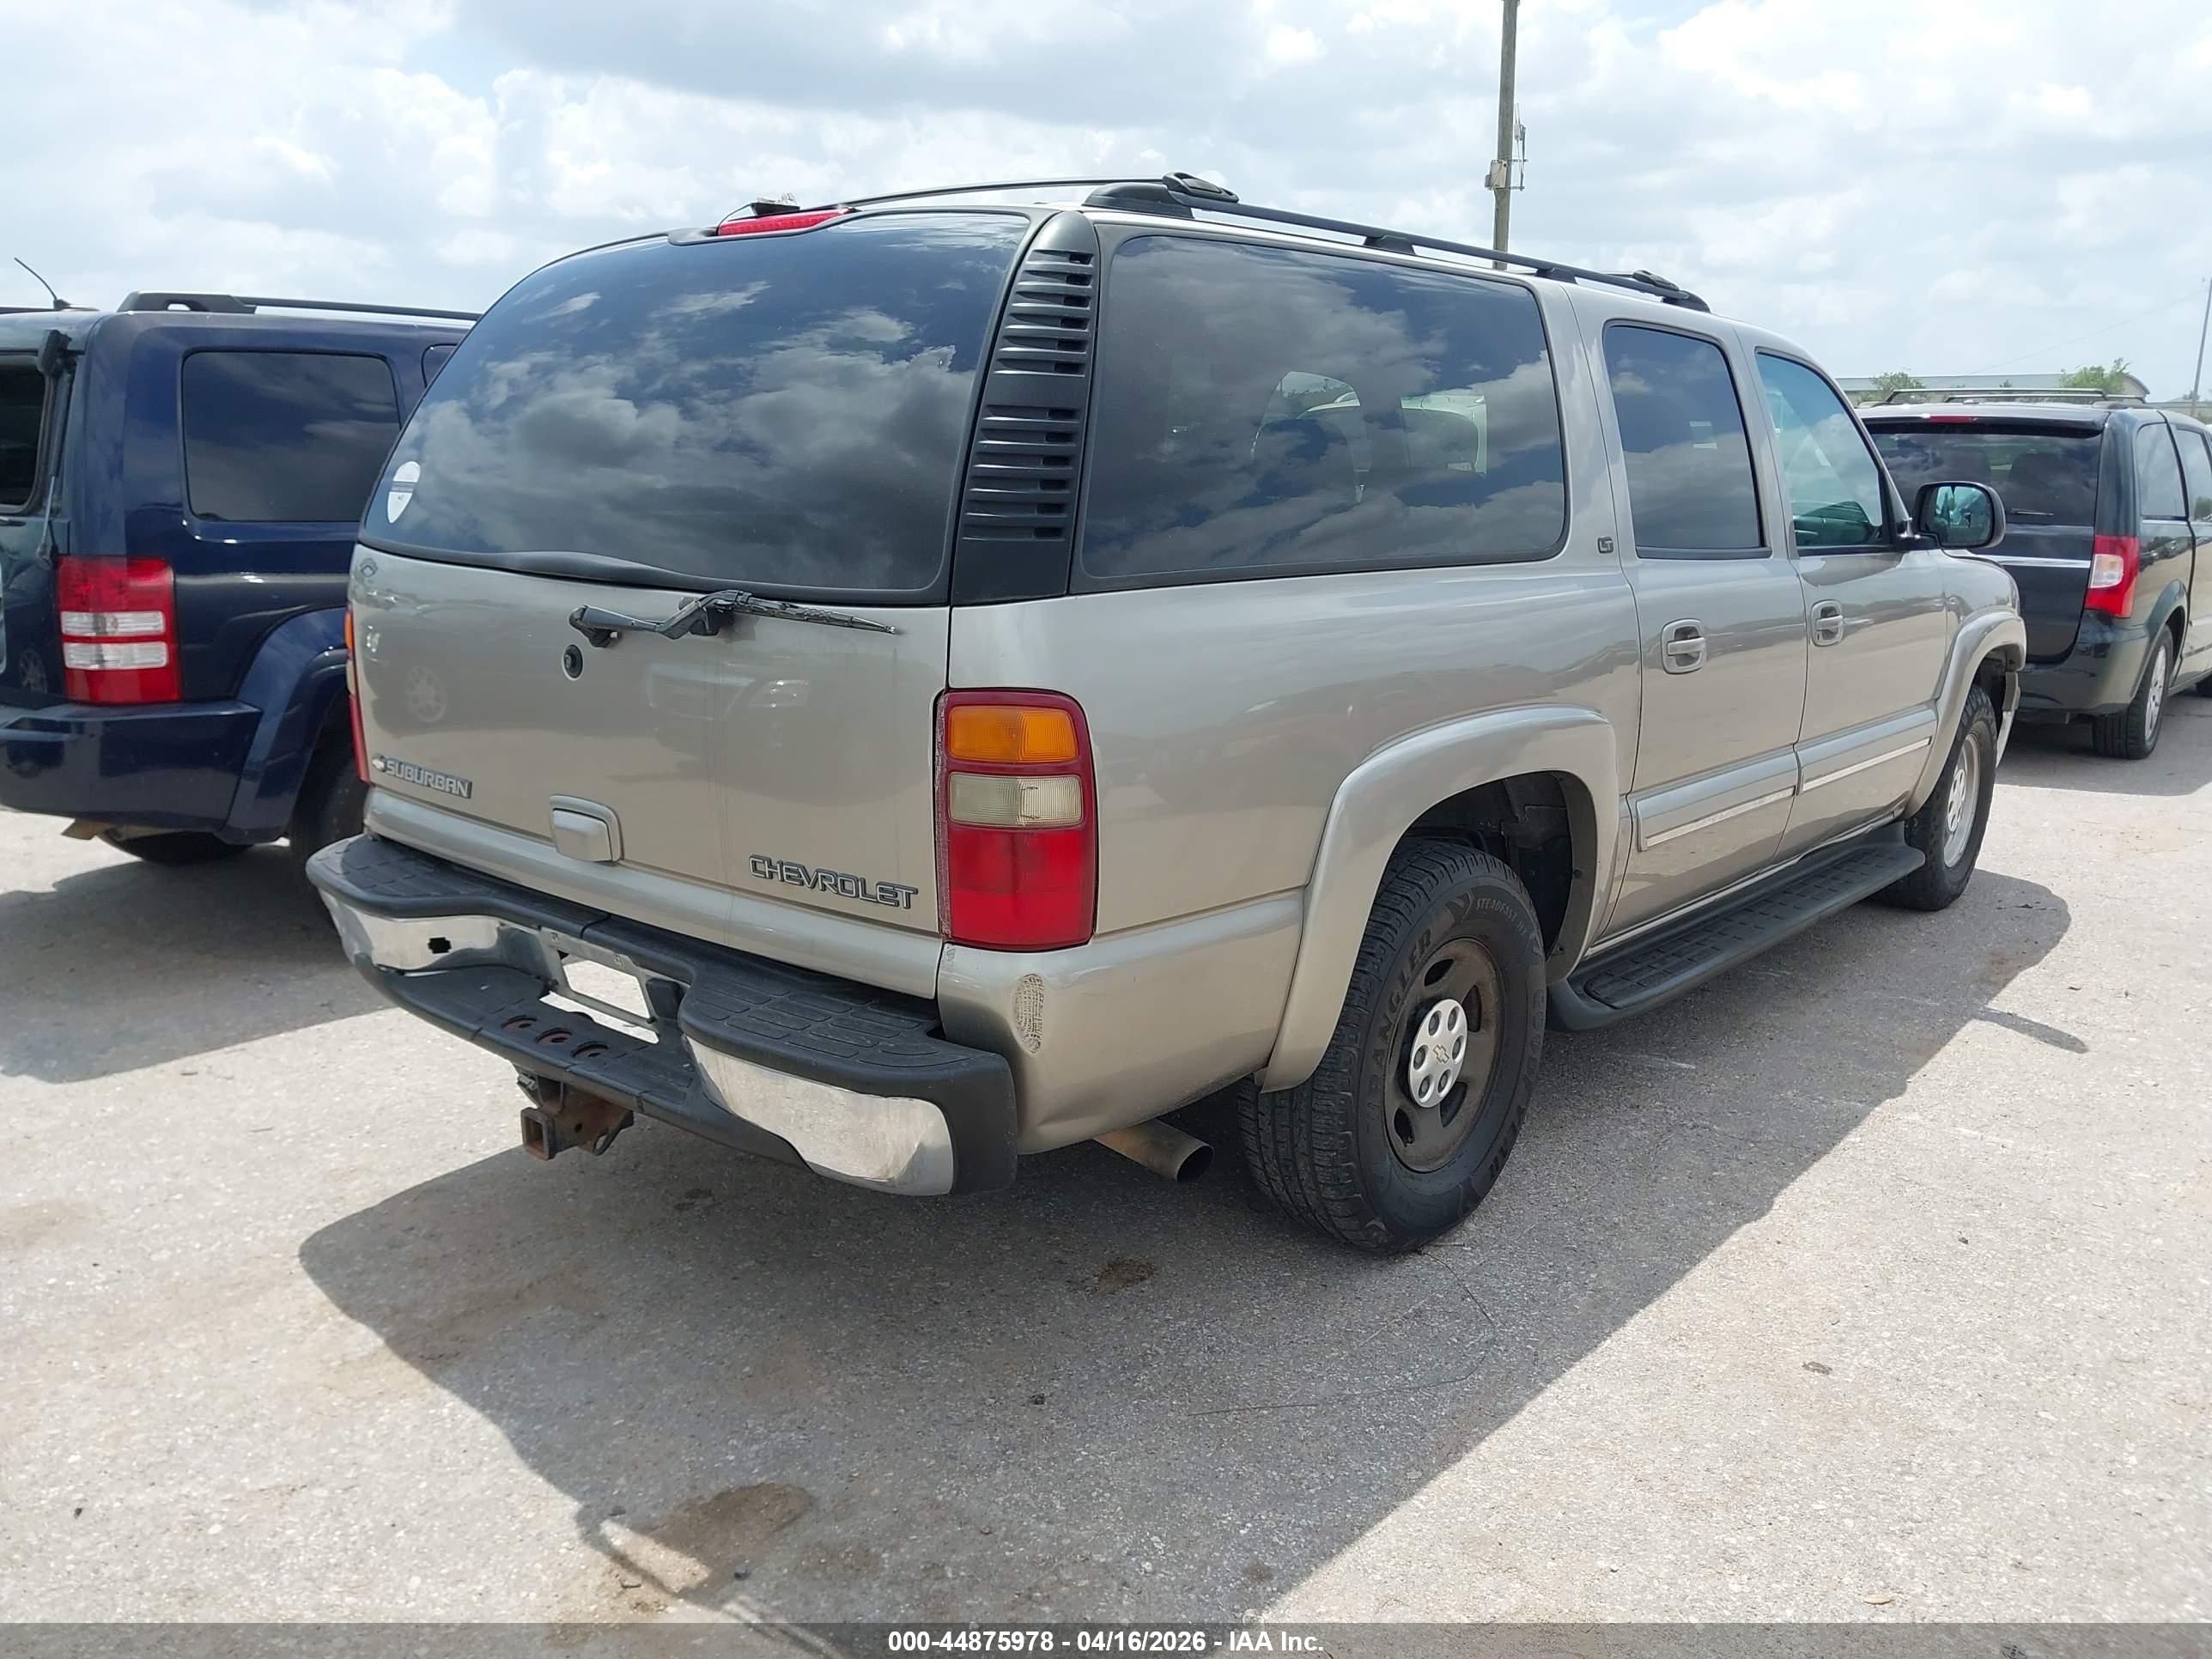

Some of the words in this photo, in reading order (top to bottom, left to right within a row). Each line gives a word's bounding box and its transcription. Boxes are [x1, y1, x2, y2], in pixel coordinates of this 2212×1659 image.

[1598, 539, 1613, 552] LT
[385, 759, 470, 798] SUBURBAN
[749, 854, 918, 908] CHEVROLET
